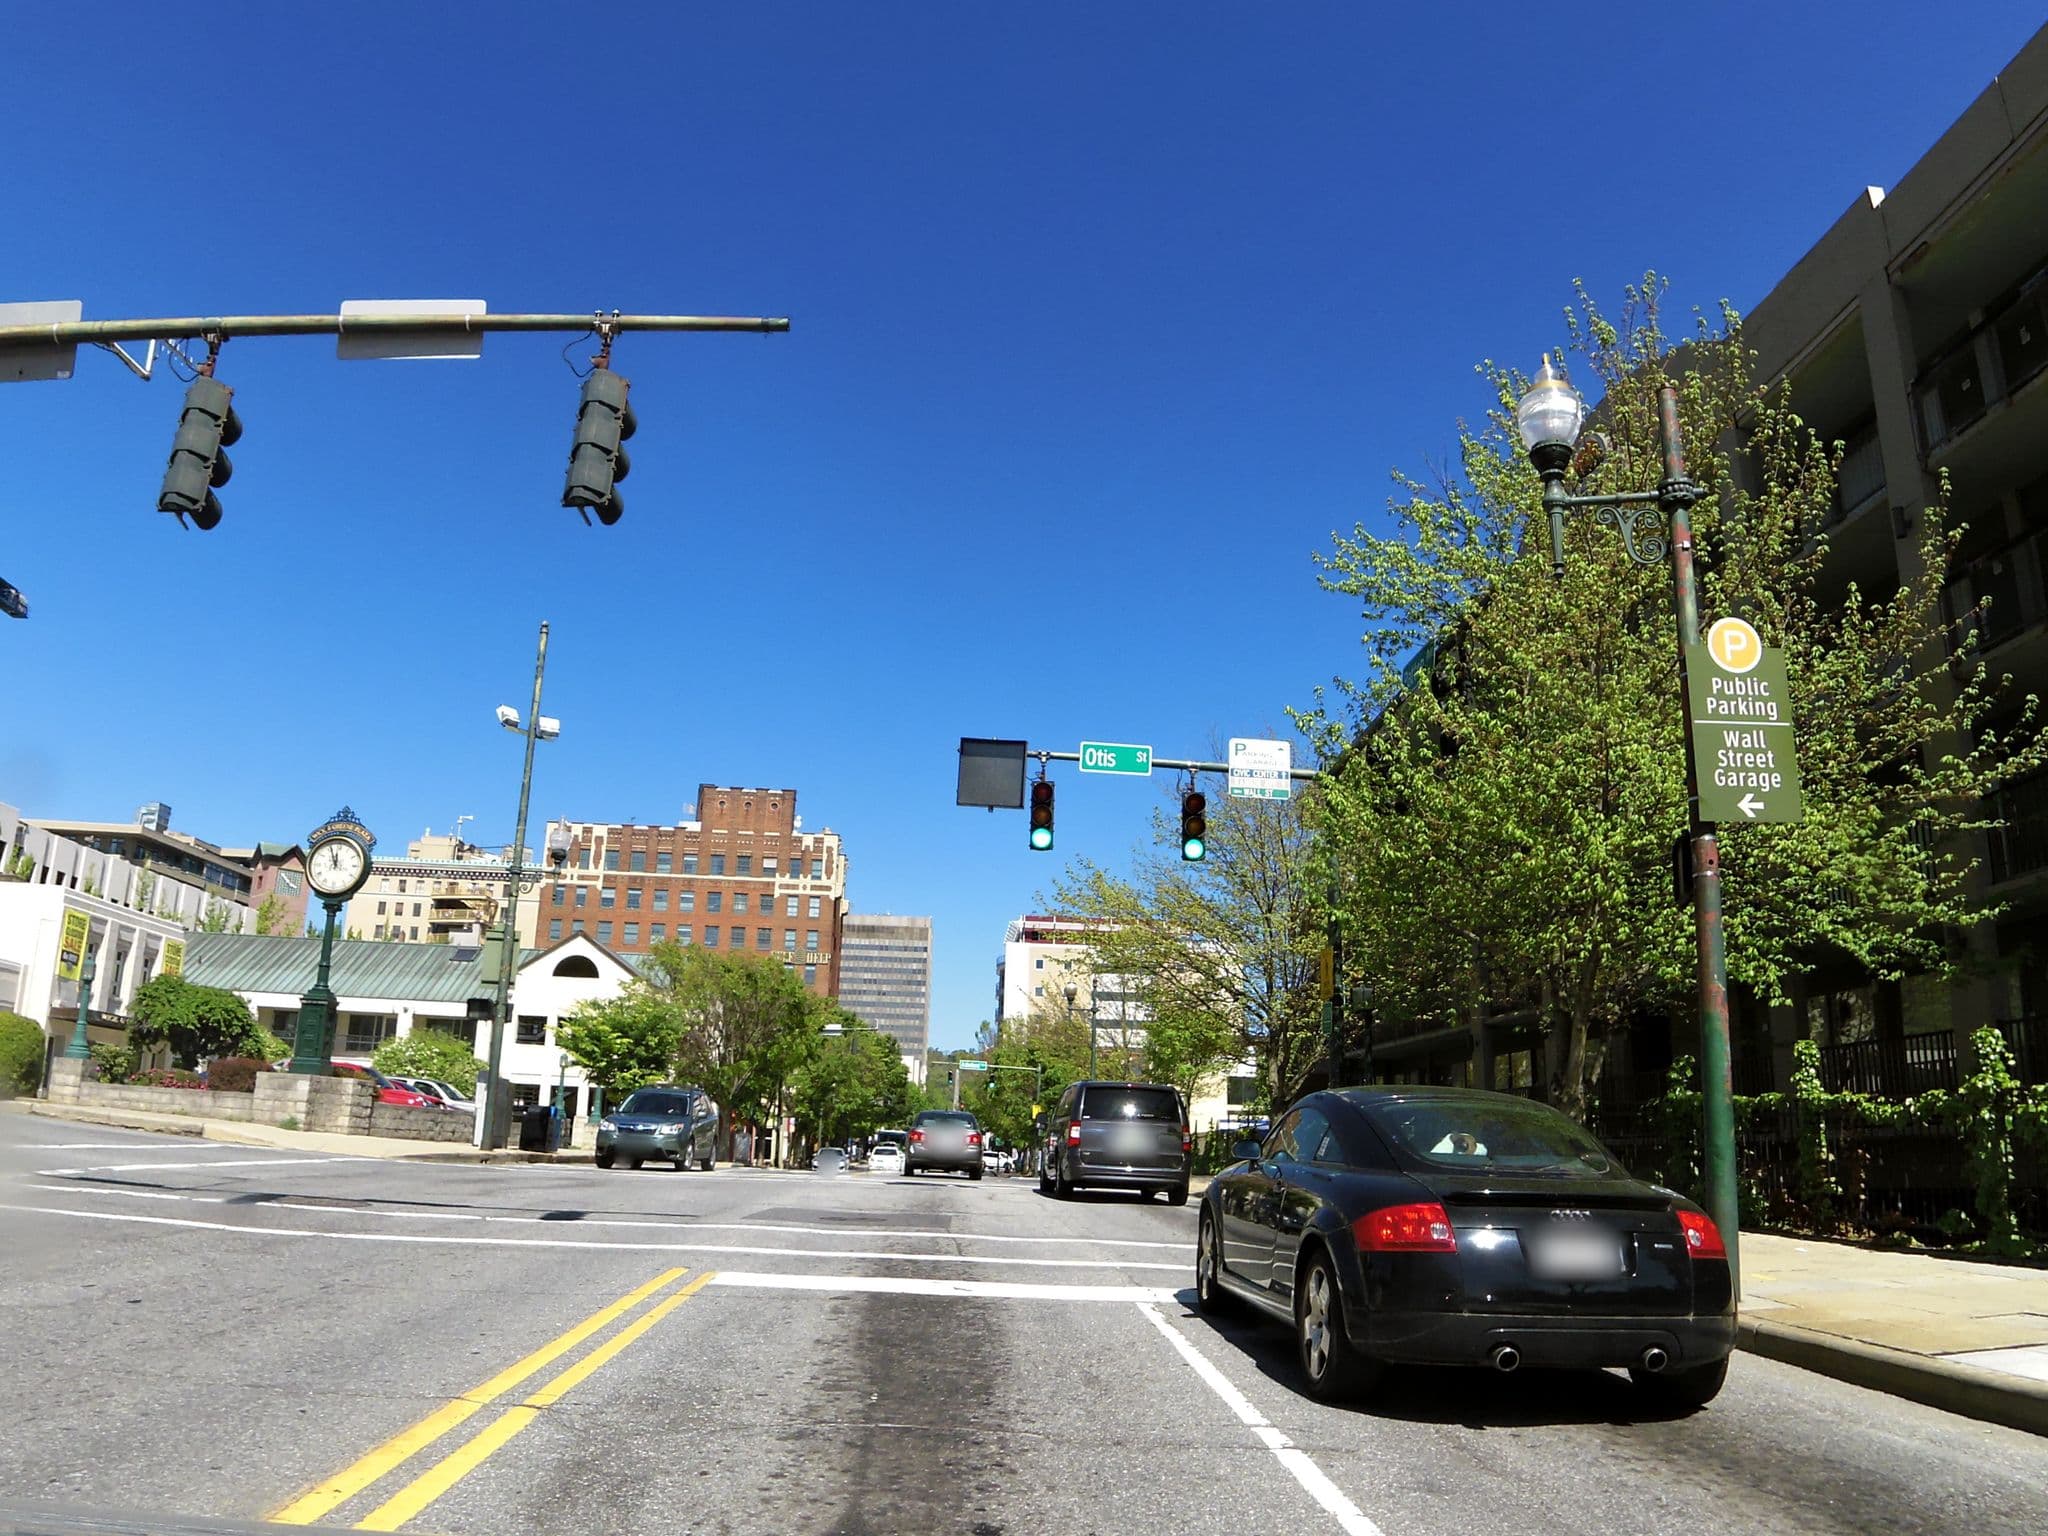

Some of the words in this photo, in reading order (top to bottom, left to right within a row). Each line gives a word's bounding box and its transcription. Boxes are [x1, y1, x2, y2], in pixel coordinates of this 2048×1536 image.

[1723, 629, 1748, 662] P
[1711, 677, 1770, 697] Public
[1706, 697, 1778, 721] Parking
[1723, 730, 1767, 749] Wall
[1085, 747, 1117, 767] Otis
[1136, 751, 1147, 763] St
[1717, 750, 1775, 768] Street
[1233, 769, 1251, 778] CIVIC
[1253, 769, 1279, 779] CENTER
[1714, 769, 1782, 792] Garage
[1243, 788, 1264, 797] WALL
[806, 952, 831, 964] HELP
